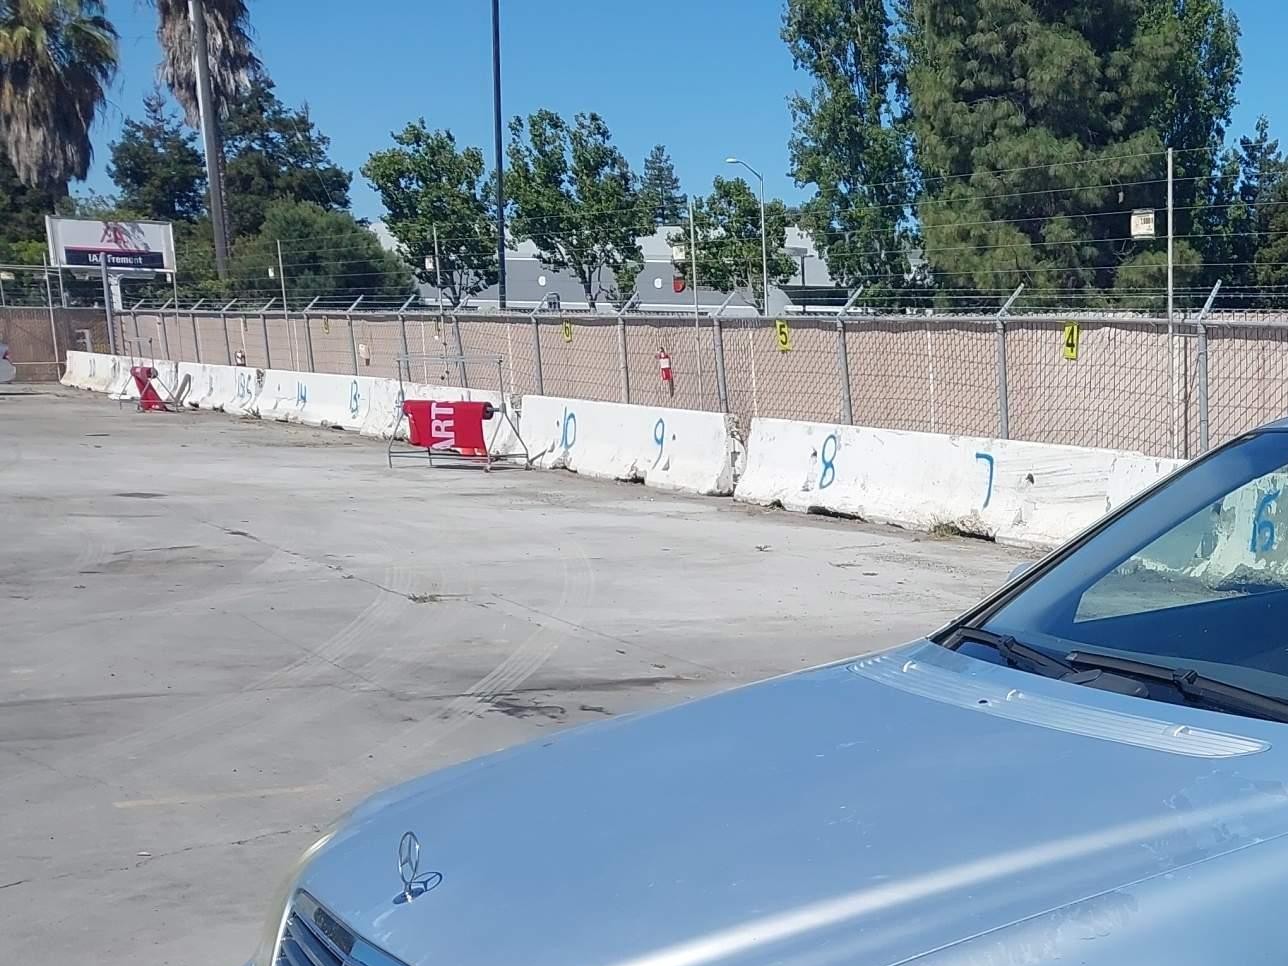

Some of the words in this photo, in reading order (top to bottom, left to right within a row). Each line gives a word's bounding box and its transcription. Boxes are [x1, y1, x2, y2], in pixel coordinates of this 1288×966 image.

[107, 254, 143, 265] Fremont
[779, 324, 788, 346] 5
[1065, 325, 1075, 353] 4
[559, 406, 577, 450] 10
[653, 417, 666, 470] 9
[819, 434, 838, 489] 8
[975, 452, 995, 509] 7
[1250, 489, 1281, 553] 6
